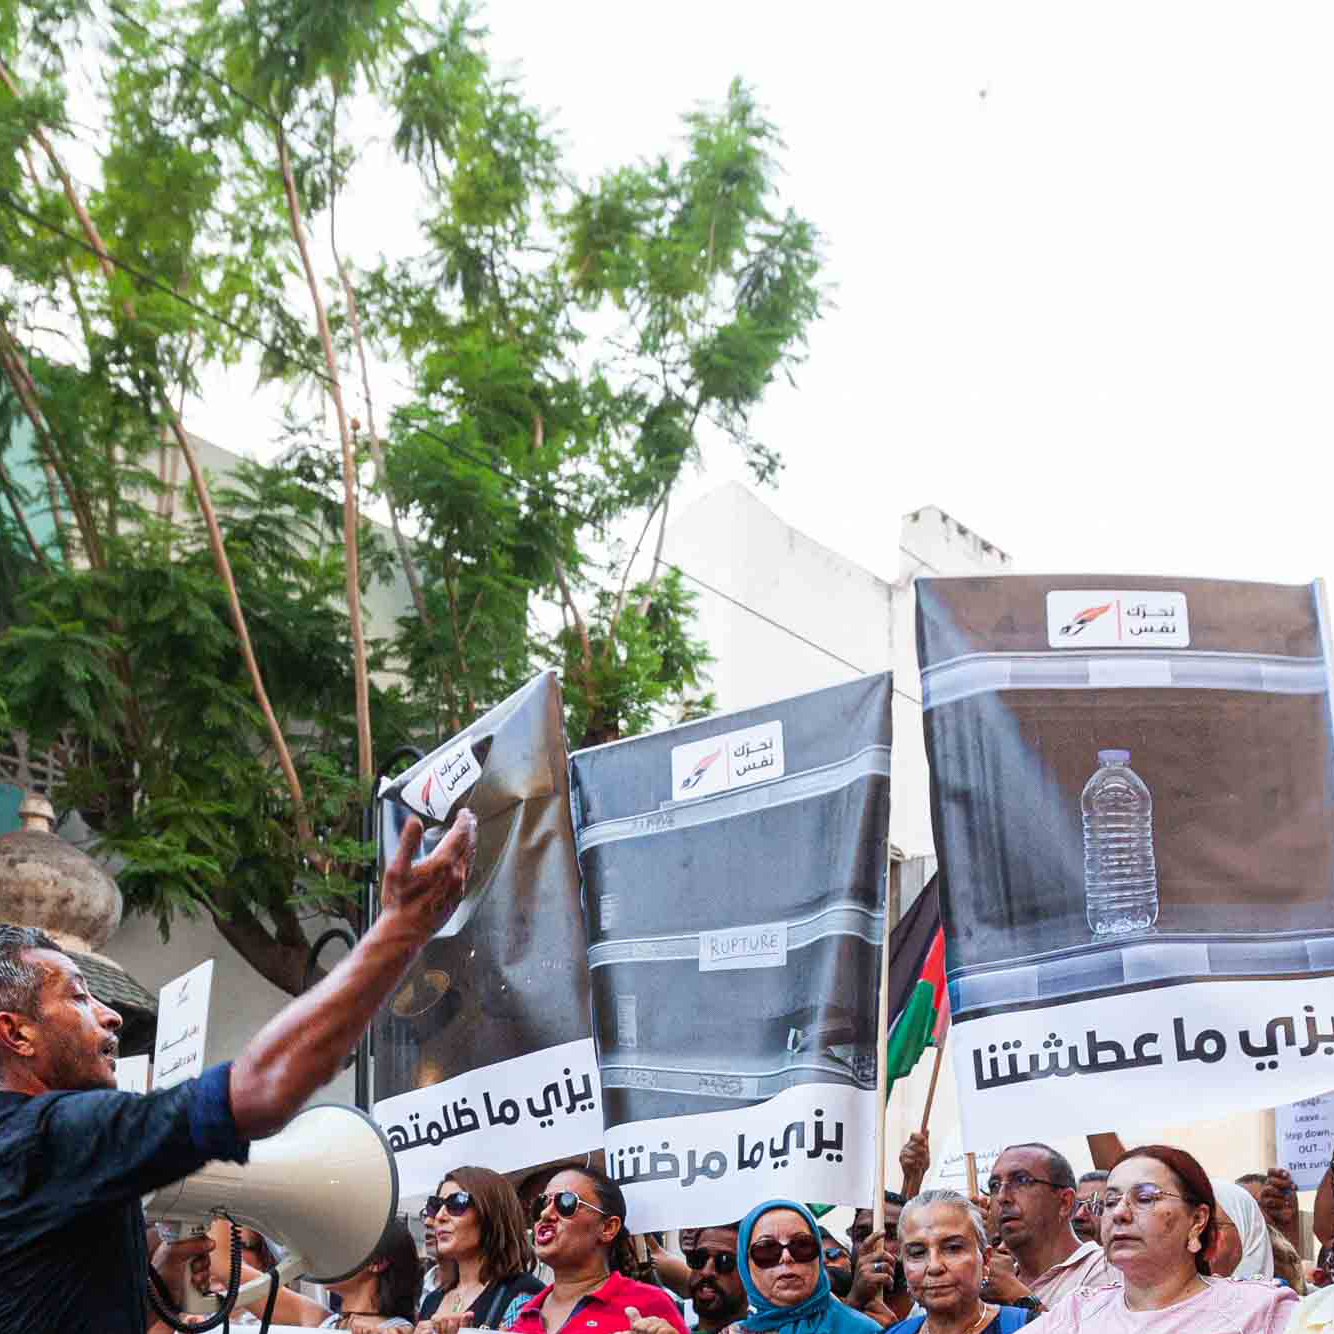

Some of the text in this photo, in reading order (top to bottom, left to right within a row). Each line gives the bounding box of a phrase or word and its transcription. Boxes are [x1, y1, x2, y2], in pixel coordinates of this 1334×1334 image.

[1129, 622, 1177, 636] نفس
[447, 762, 471, 791] نفس
[735, 753, 774, 777] نفس
[709, 932, 780, 956] RUPTURE
[1172, 1016, 1228, 1063] ما
[972, 1030, 1164, 1091] عطشتنا
[482, 1091, 521, 1127] ما
[526, 1067, 596, 1129] يزي
[609, 1108, 844, 1188] يزي ما مرضتنا
